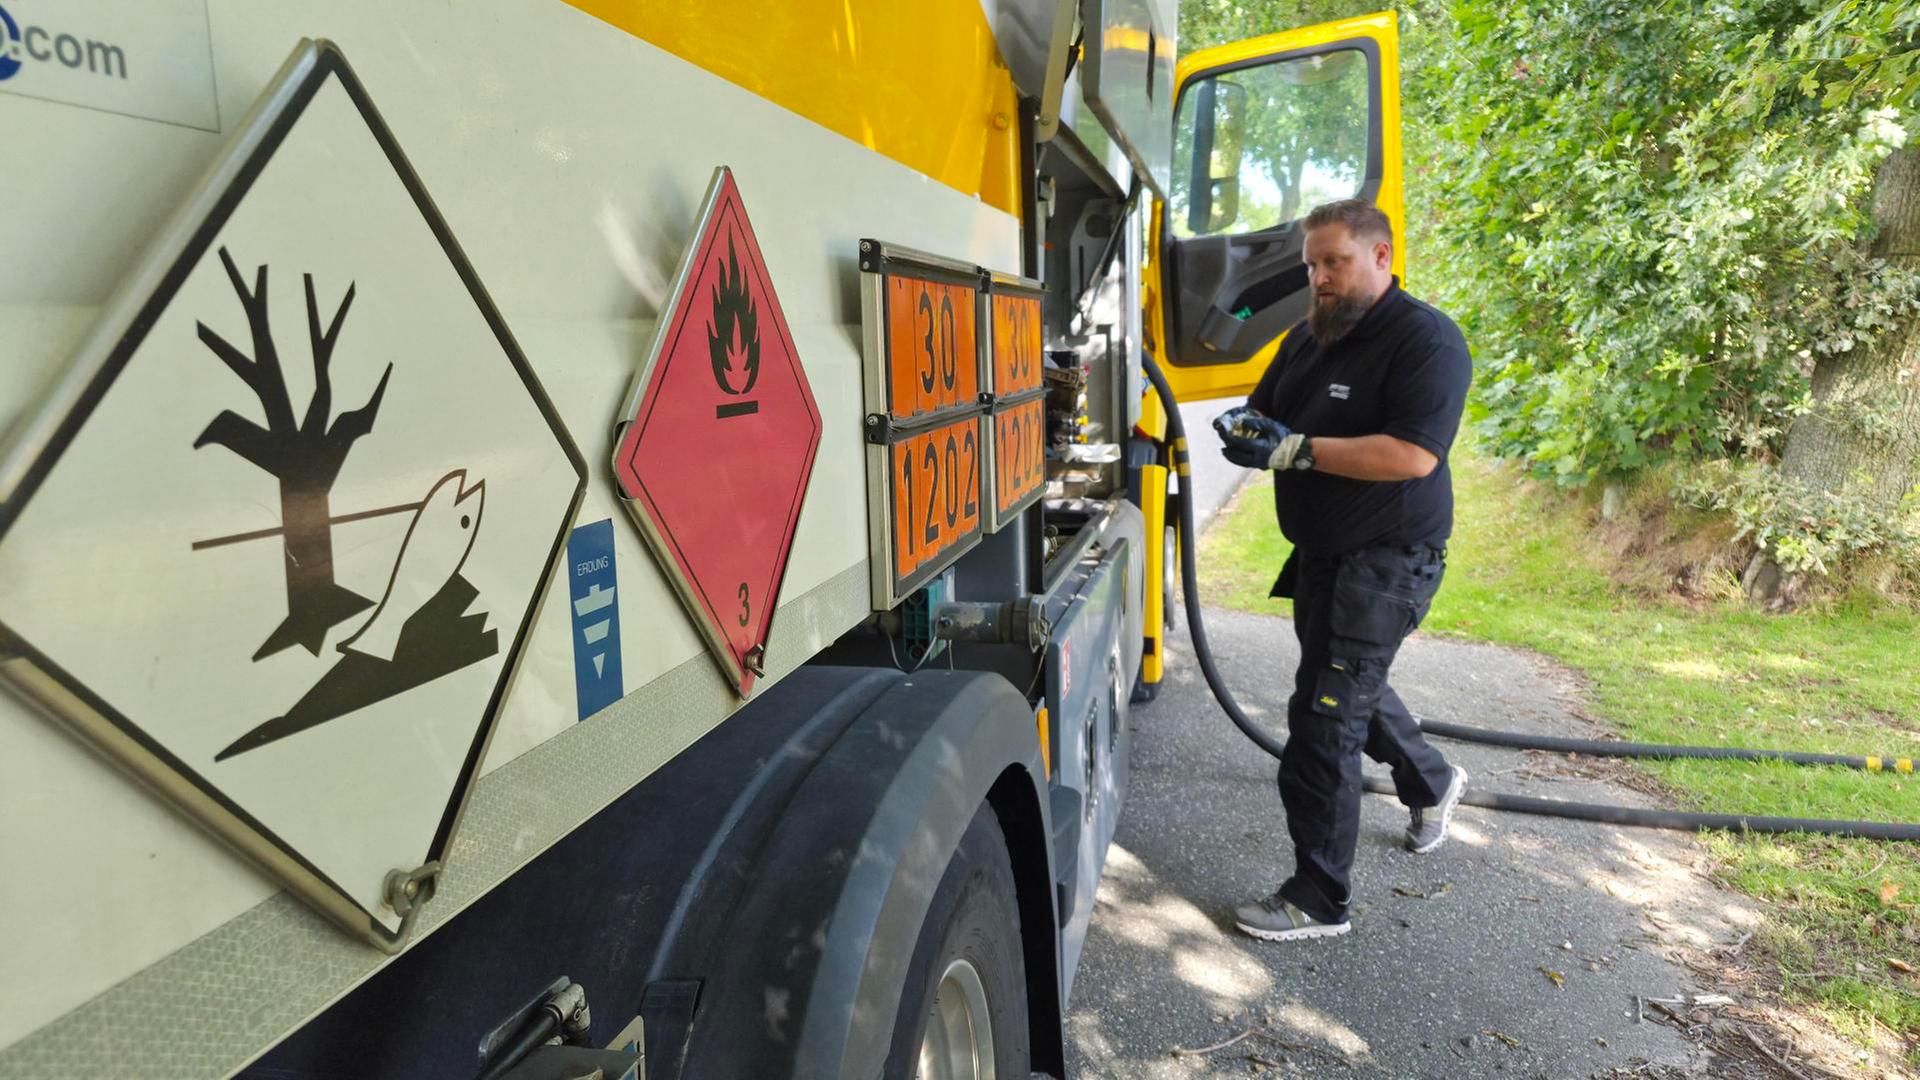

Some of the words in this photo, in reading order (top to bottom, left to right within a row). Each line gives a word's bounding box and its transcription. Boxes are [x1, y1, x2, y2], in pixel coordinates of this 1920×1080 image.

[0, 24, 127, 79] .com
[919, 291, 955, 394] 30
[1008, 303, 1029, 380] 30
[1001, 407, 1042, 498] 1202
[903, 429, 977, 556] 1202
[577, 555, 609, 577] ERDUNG
[738, 582, 750, 628] 3
